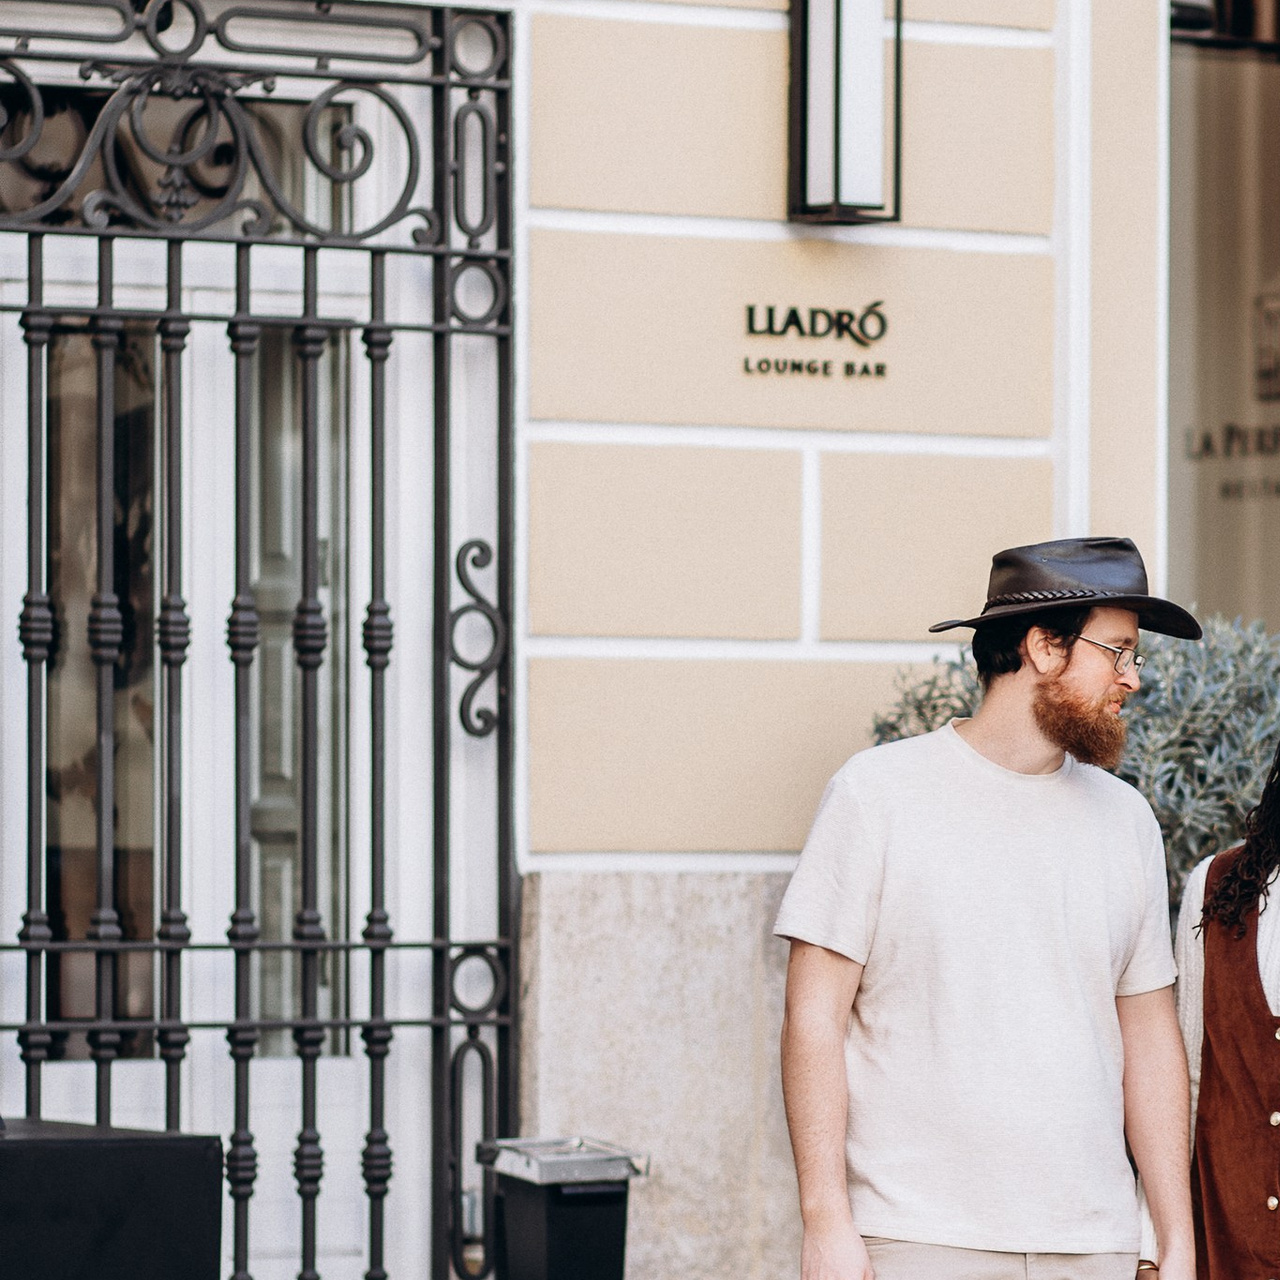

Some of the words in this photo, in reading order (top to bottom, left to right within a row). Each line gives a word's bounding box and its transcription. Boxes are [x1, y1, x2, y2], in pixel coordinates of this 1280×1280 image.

[745, 300, 888, 347] LLADRÓ
[743, 356, 832, 377] LOUNGE
[843, 362, 887, 377] BAR
